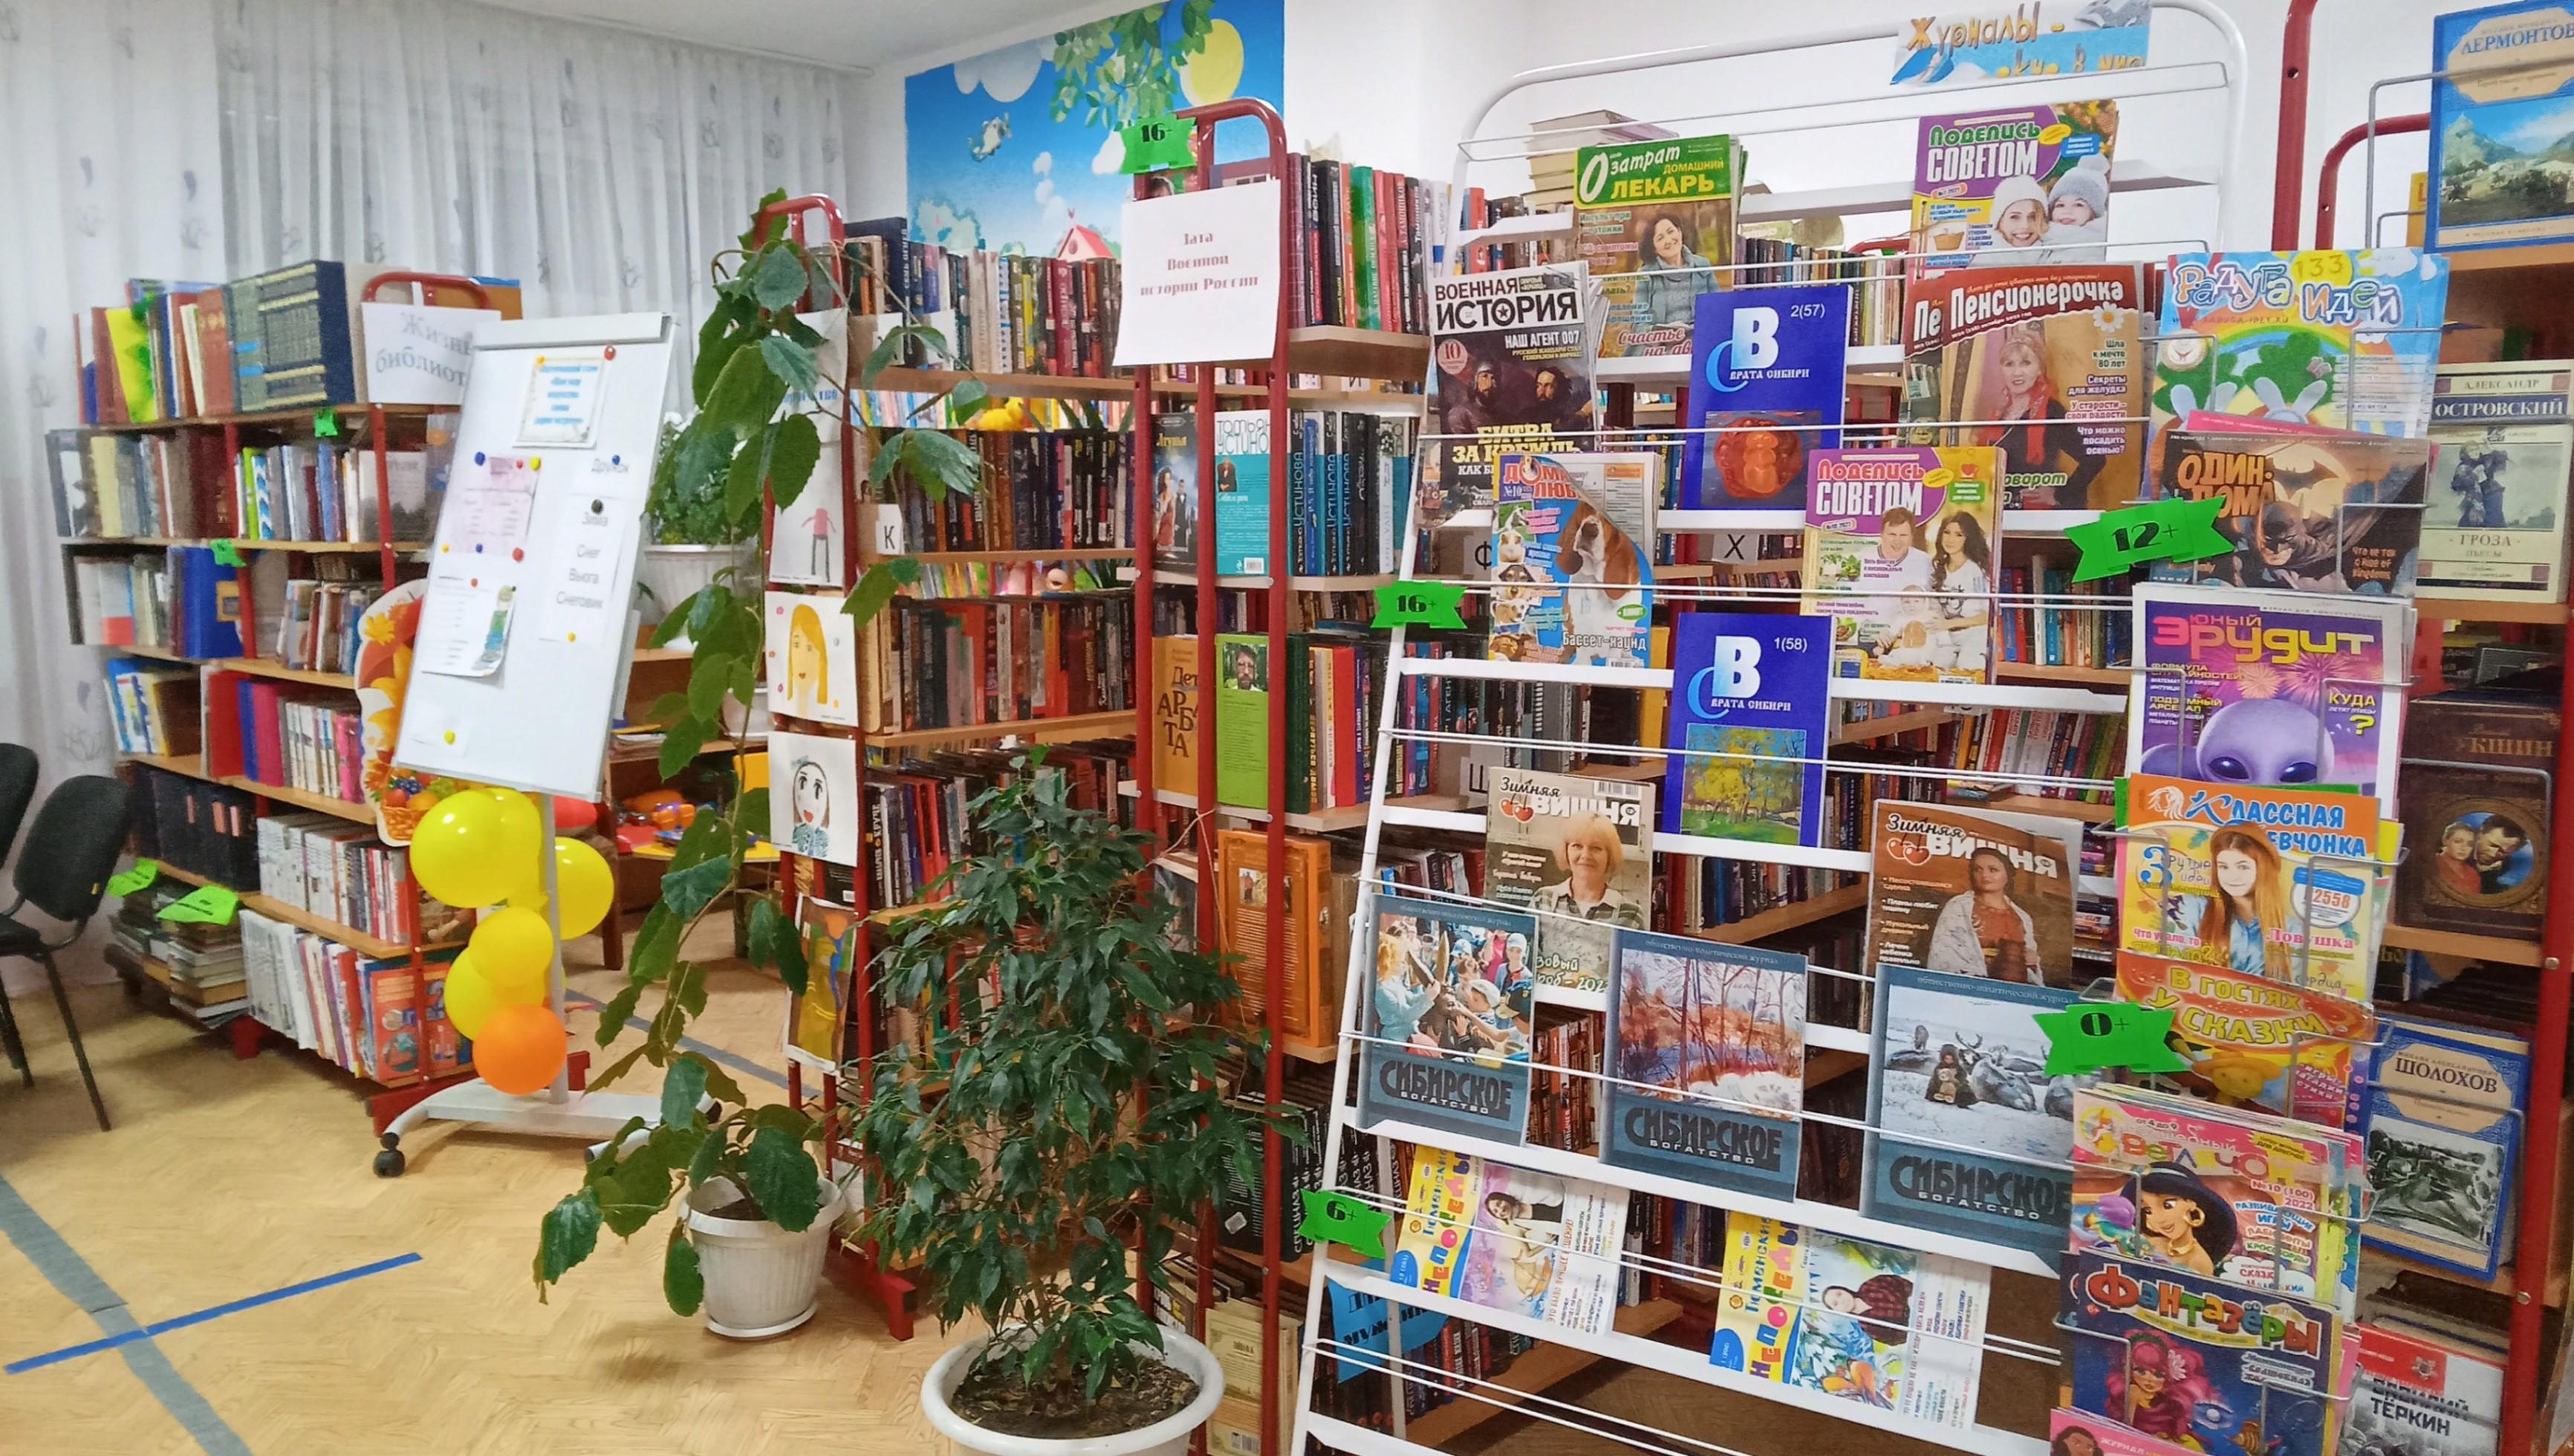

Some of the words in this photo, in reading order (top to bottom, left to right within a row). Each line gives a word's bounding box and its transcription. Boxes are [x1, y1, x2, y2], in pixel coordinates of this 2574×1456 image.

[1611, 146, 1680, 176] затрат
[1663, 158, 1724, 175] ДОМАШНИЙ
[1926, 139, 2039, 183] СОВЕТОМ
[1611, 173, 1715, 200] ЛЕКАРЬ
[1140, 282, 1197, 297] истории
[1203, 276, 1259, 291] России
[1434, 278, 1518, 300] ВОЕННАЯ
[1435, 291, 1578, 331] ИСТОРИЯ
[1790, 304, 1825, 319] 2(57)
[1951, 280, 2124, 331] Пенсионерочка
[1504, 334, 1528, 349] НАШ
[1530, 331, 1560, 347] АГЕНТ
[1561, 330, 1579, 345] 007
[2106, 340, 2125, 348] Шла
[1444, 345, 1460, 360] 10
[1729, 369, 1764, 381] ВРАТА
[1767, 368, 1810, 379] СИБИРИ
[2087, 375, 2126, 386] Секреты
[2087, 386, 2126, 395] желудка
[2079, 401, 2119, 411] старости
[2089, 412, 2126, 420] радости
[2434, 397, 2563, 417] ОСТРОВСКИЙ
[2077, 426, 2093, 435] Что
[1452, 444, 1486, 464] ЗА
[2086, 446, 2125, 455] осенью?
[1458, 465, 1481, 475] КАК
[1533, 483, 1579, 499] ЛЮБ
[1816, 481, 1923, 517] СОВЕТОМ
[884, 524, 895, 550] К
[1724, 533, 1745, 560] Х
[2110, 520, 2177, 552] 12+
[2460, 533, 2512, 547] ГРОЗА
[1396, 594, 1437, 614] 16+
[2189, 614, 2261, 627] ЮНЫЙ
[1563, 631, 1647, 651] Бассет-хаунд
[1773, 637, 1808, 653] 1(58)
[1171, 666, 1198, 687] Дет
[1711, 698, 1745, 709] ВРАТА
[1748, 700, 1792, 712] СИБИРИ
[2149, 703, 2202, 713] АРСЕАЛ
[2150, 696, 2222, 706] ПОДЗМНЫЙ
[2329, 693, 2375, 706] КУДА
[1501, 776, 1561, 799] Зимняя
[1535, 795, 1641, 827] ВИШНЯ
[1887, 814, 1965, 839] Зимняя
[2268, 830, 2366, 857] ЕВЧОНКА
[2140, 845, 2173, 886] 3
[2314, 889, 2350, 909] 2558
[2266, 928, 2355, 949] Ловшка
[1536, 954, 1580, 972] зовый
[2170, 967, 2192, 990] В
[2148, 987, 2180, 1009] У
[2080, 1012, 2130, 1037] 0+
[2180, 1006, 2330, 1044] СКАЗКИ
[2395, 1057, 2497, 1093] ШОЛОХОВ
[1379, 1059, 1514, 1114] СИБИРСКОЕ
[1400, 1091, 1489, 1115] БОГАТСТВО
[1625, 1106, 1782, 1163] СИБИРСКОЕ
[1650, 1139, 1755, 1165] БОГАТСТВО
[1889, 1155, 2073, 1216] СИБИРСКОЕ
[1326, 1200, 1357, 1222] 6+
[1918, 1191, 2041, 1221] БОГАТСТВО
[2240, 1268, 2275, 1279] СКАЗК
[1343, 1306, 1428, 1345] мужин
[2370, 1397, 2451, 1437] ТЁРКИН
